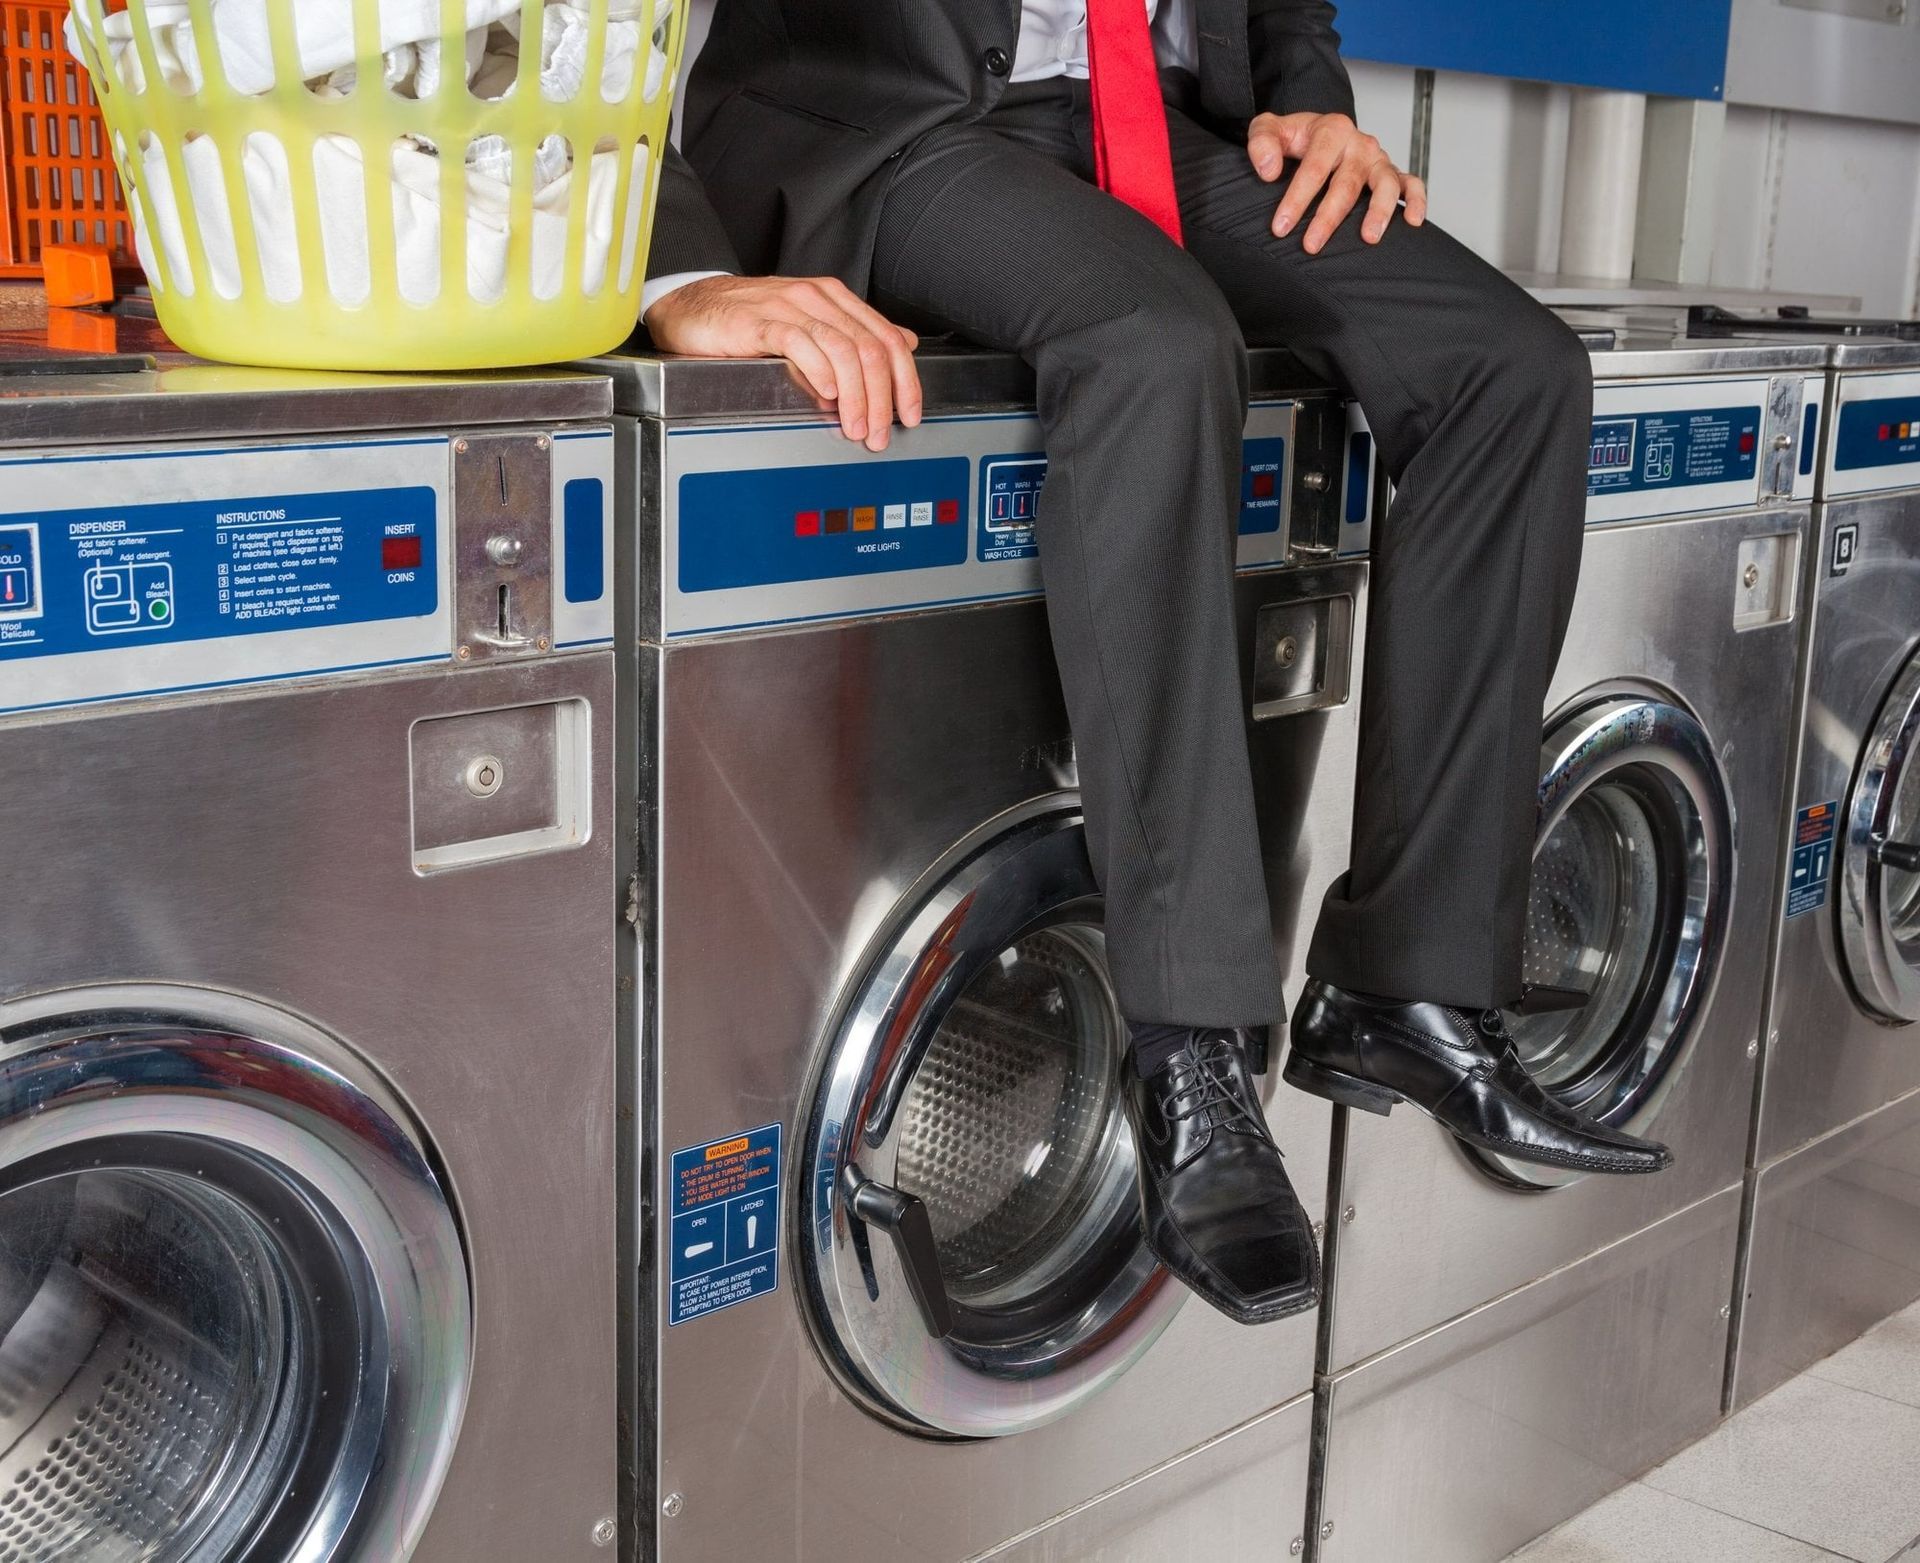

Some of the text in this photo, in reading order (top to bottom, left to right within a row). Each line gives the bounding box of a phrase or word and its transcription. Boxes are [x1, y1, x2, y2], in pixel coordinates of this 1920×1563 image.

[217, 510, 285, 524] INSTRUCTIONS
[69, 521, 126, 534] DISPENSER
[385, 524, 415, 535] INSERT
[246, 531, 278, 541] detergent
[287, 537, 319, 546] dispenser
[96, 539, 115, 547] fabric
[857, 542, 900, 553] MODE LIGHTS
[1840, 538, 1850, 558] 8
[78, 548, 113, 558] (Optional)
[233, 551, 239, 559] of
[242, 549, 271, 558] machine
[274, 548, 288, 556] (see
[290, 545, 317, 554] diagram
[985, 550, 1022, 560] WASH CYCLE
[234, 564, 251, 572] Load
[302, 557, 316, 565] door
[234, 577, 256, 585] Select
[387, 572, 415, 583] COINS
[146, 590, 170, 599] Bleach
[234, 589, 254, 597] Insert
[242, 601, 265, 609] bleach
[307, 596, 320, 604] add
[235, 611, 252, 619] ADD
[254, 608, 284, 617] BLEACH
[287, 607, 300, 615] light
[303, 604, 325, 612] comes
[0, 622, 22, 630] Wool
[1, 629, 35, 639] Delicate
[709, 1141, 745, 1157] WARNING
[691, 1167, 701, 1175] NOT
[724, 1157, 738, 1165] OPEN
[740, 1151, 755, 1162] DOOR
[756, 1147, 771, 1157] WHEN
[686, 1179, 696, 1187] THE
[698, 1174, 713, 1184] DRUM
[721, 1165, 745, 1176] TURNING
[686, 1188, 697, 1196] YOU
[699, 1185, 709, 1193] SEE
[711, 1178, 729, 1190] WATER
[737, 1173, 747, 1181] THE
[747, 1166, 770, 1177] WINDOW
[685, 1197, 697, 1206] ANY
[698, 1192, 714, 1201] MODE
[715, 1186, 730, 1197] LIGHT
[738, 1182, 746, 1190] ON
[740, 1199, 764, 1212] LATCHED
[692, 1217, 707, 1227] OPEN
[679, 1291, 686, 1299] IN
[686, 1286, 700, 1298] CASE
[702, 1283, 709, 1292] OF
[710, 1277, 729, 1289] POWER
[680, 1297, 698, 1308] ALLOW
[707, 1286, 730, 1299] MINUTES
[731, 1278, 751, 1291] BEFORE
[679, 1301, 712, 1317] ATTEMPTING
[721, 1292, 735, 1302] OPEN
